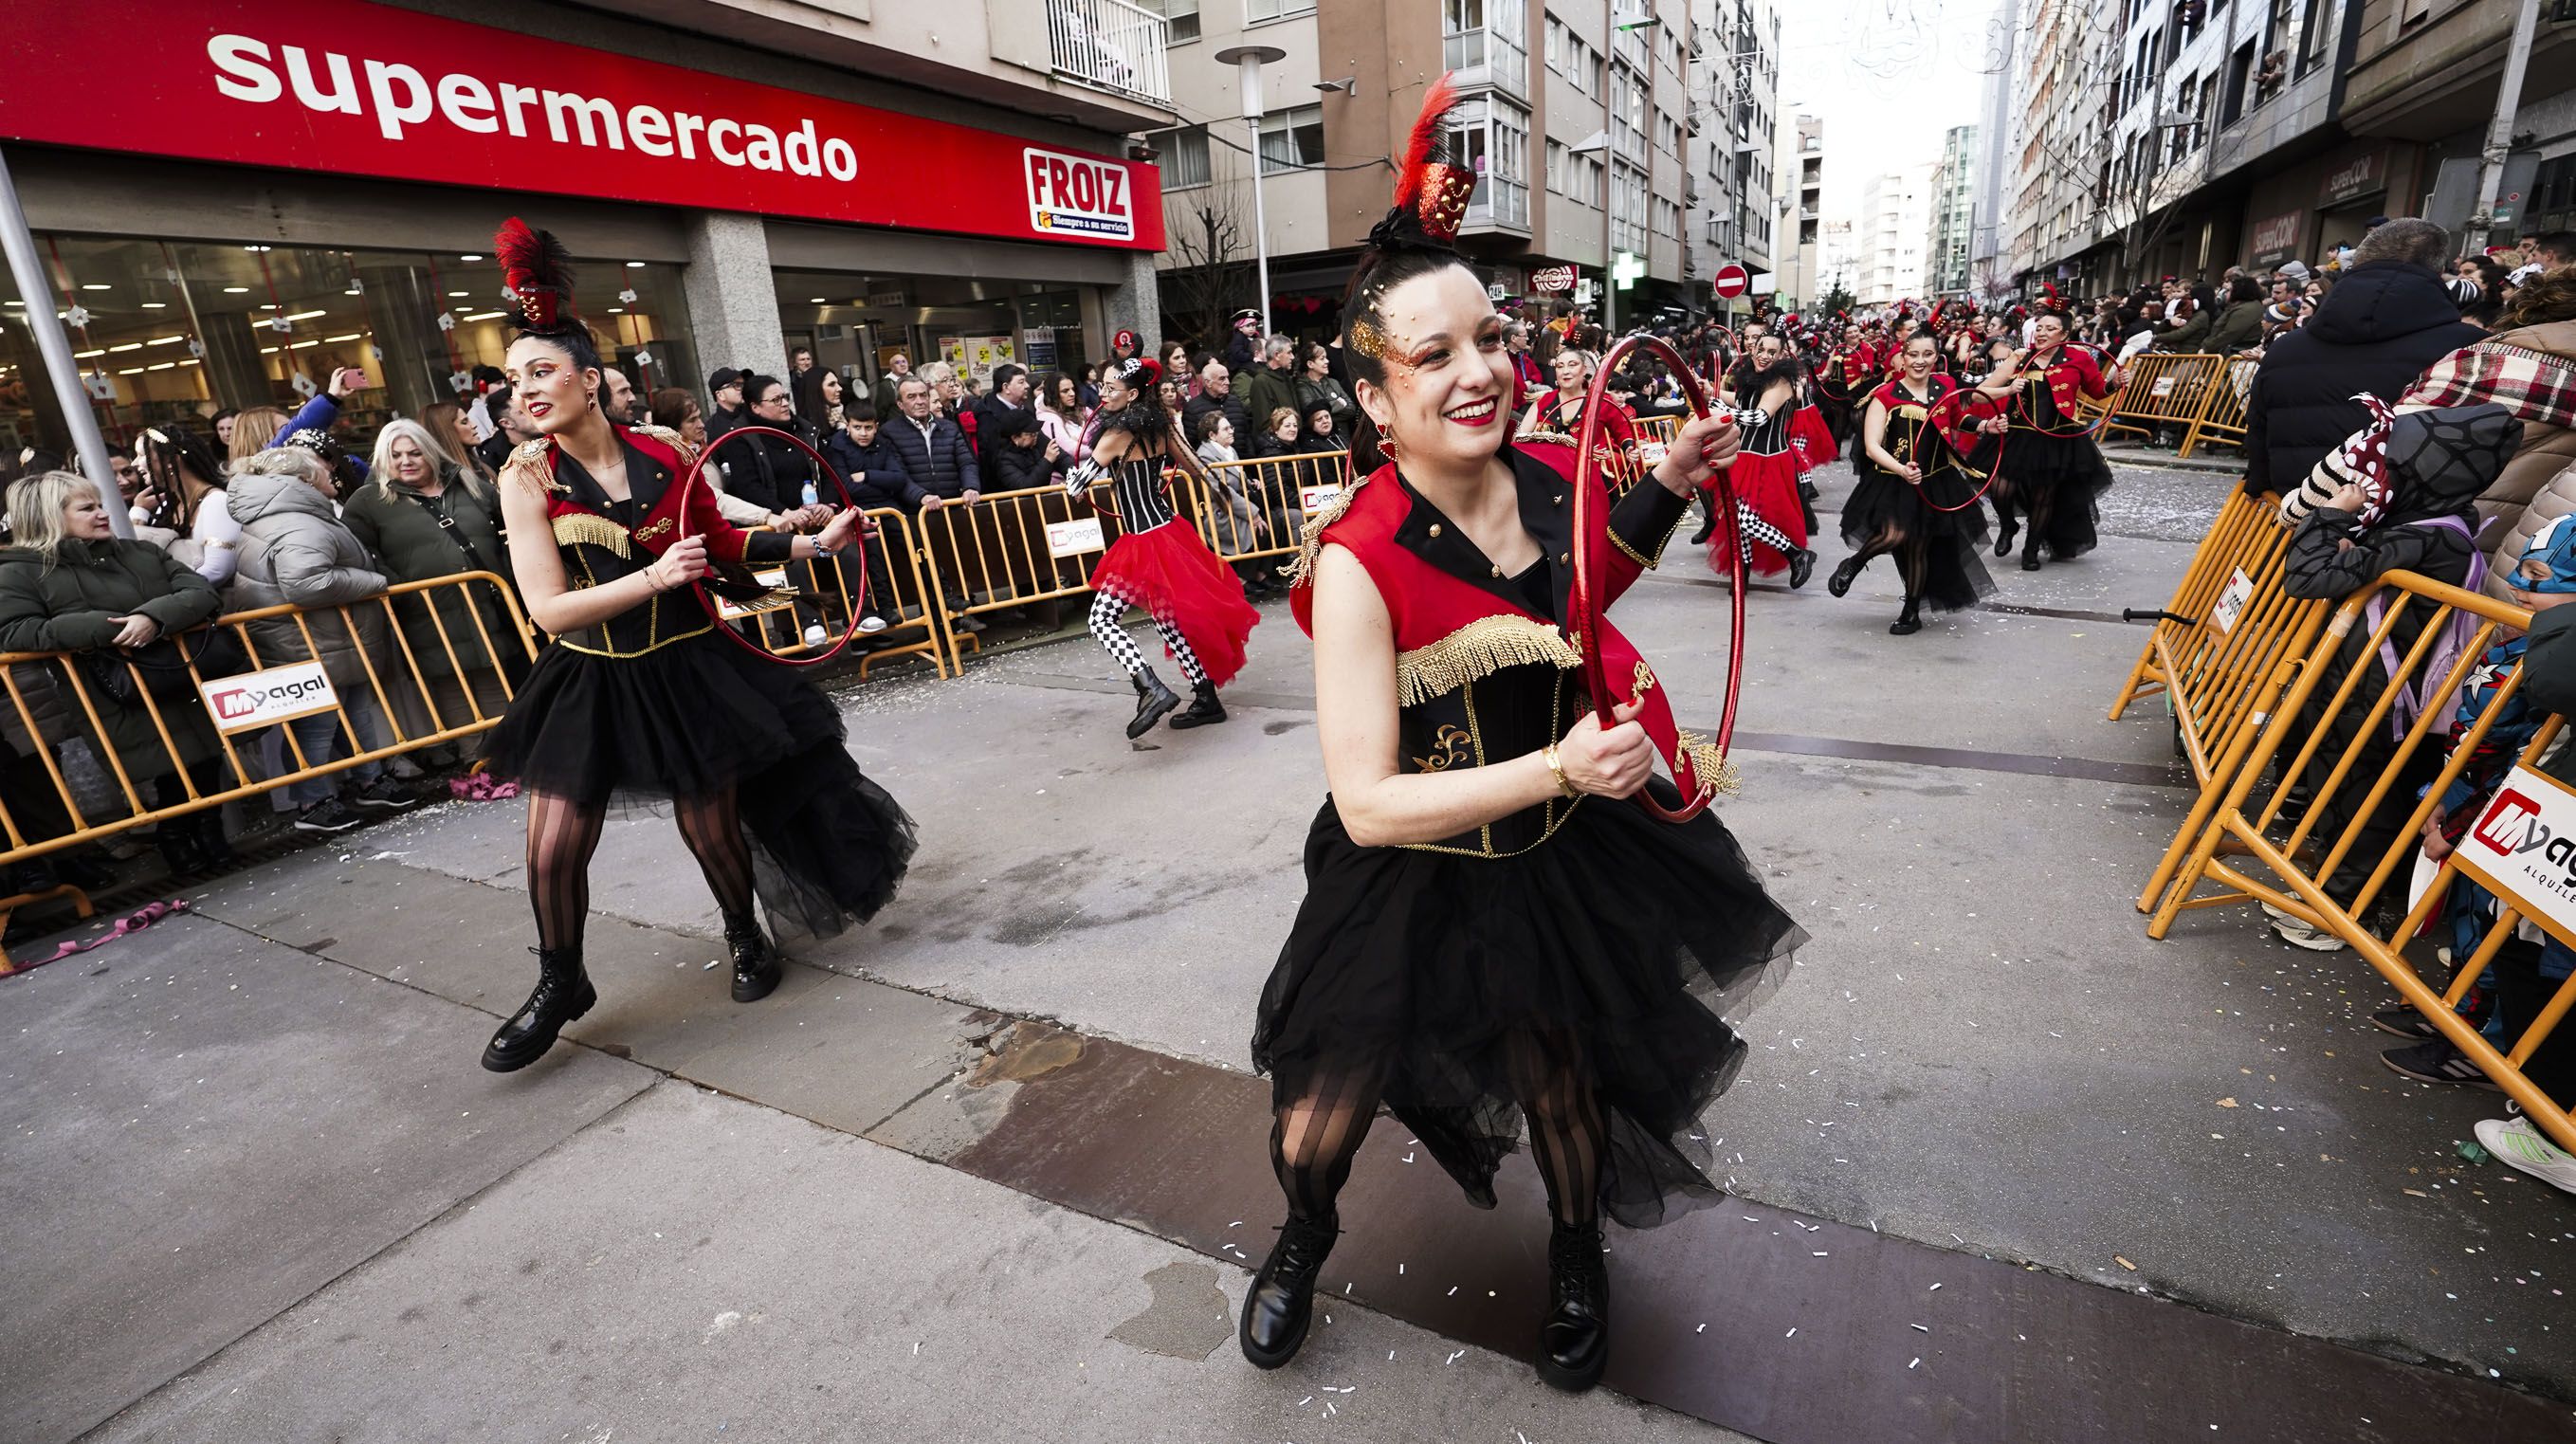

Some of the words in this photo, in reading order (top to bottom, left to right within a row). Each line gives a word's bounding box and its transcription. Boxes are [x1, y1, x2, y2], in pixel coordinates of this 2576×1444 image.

[207, 33, 858, 182] supermercado
[1030, 155, 1126, 216] FROIZ
[1052, 214, 1084, 229] Siempre
[1085, 220, 1090, 228] a
[1090, 221, 1100, 229] su
[1100, 222, 1128, 232] servicio
[1489, 286, 1503, 299] 24H
[214, 675, 325, 718] Myagal
